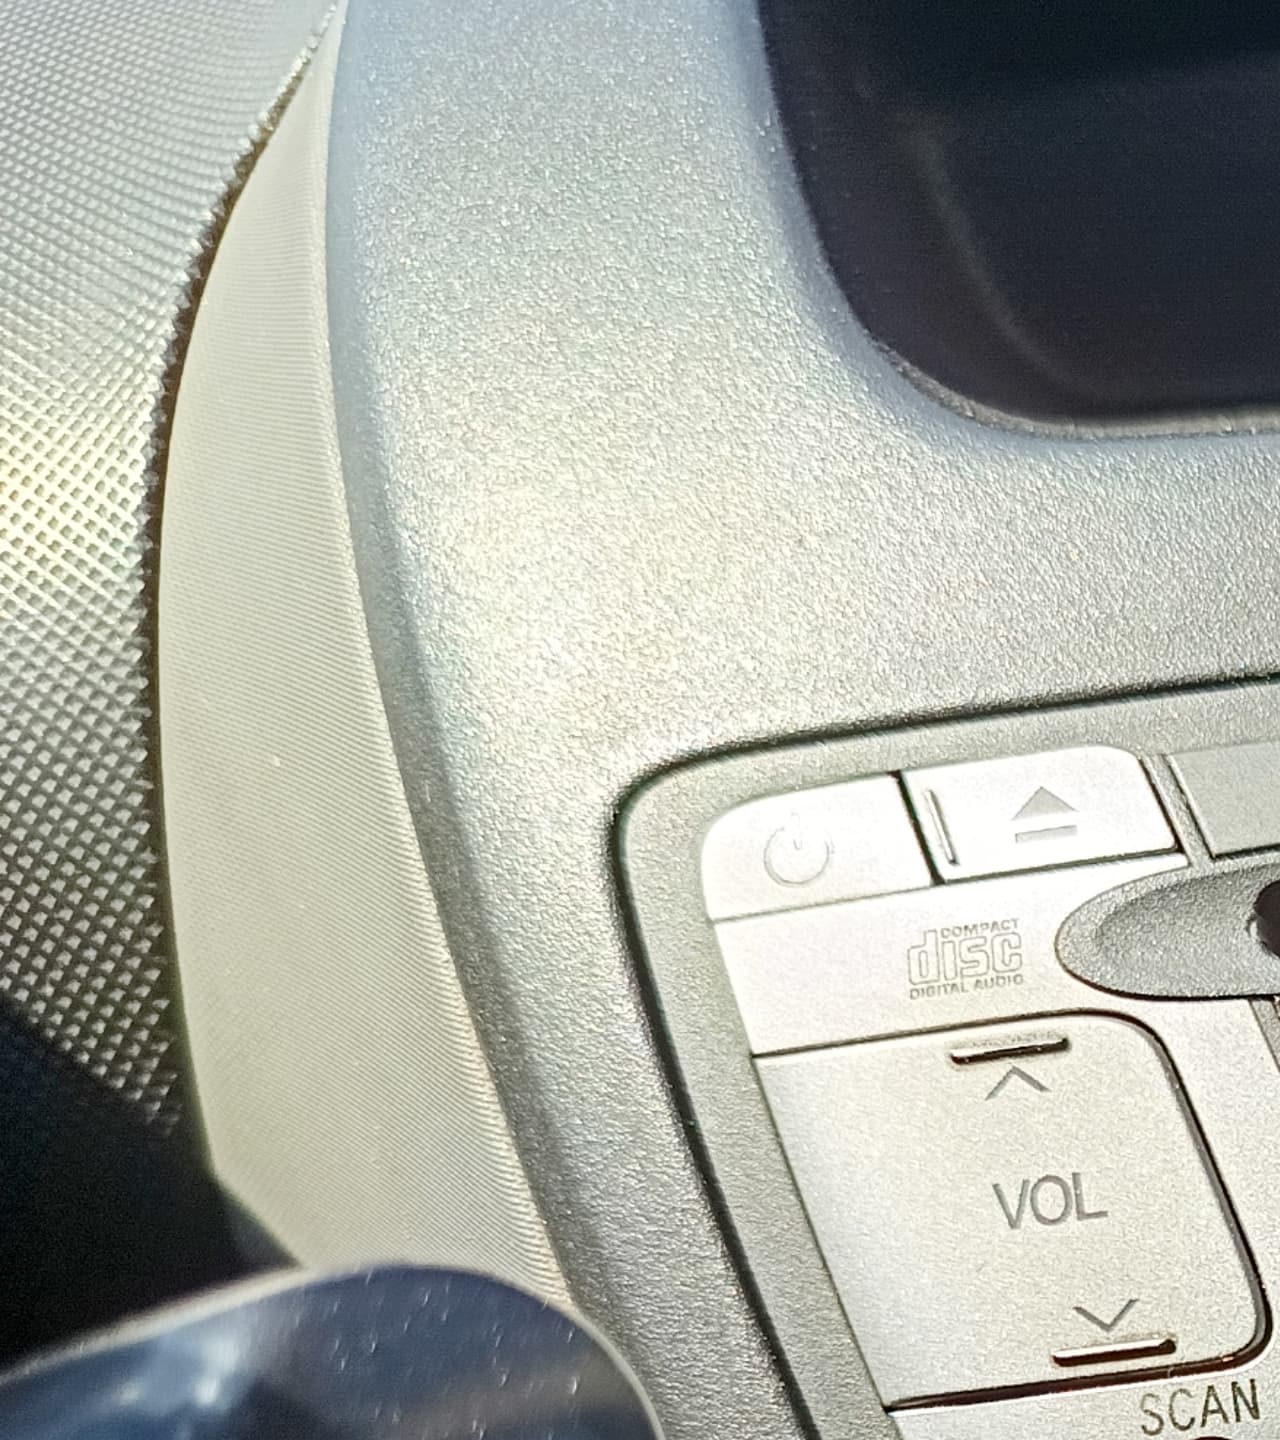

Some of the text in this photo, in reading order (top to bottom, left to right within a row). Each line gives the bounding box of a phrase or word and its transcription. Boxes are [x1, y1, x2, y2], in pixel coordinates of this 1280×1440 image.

[940, 918, 1019, 939] COMPACT
[909, 974, 1024, 1000] DIGITAL AUDIO
[993, 1172, 1108, 1230] VOL
[1140, 1380, 1261, 1436] SCAN
